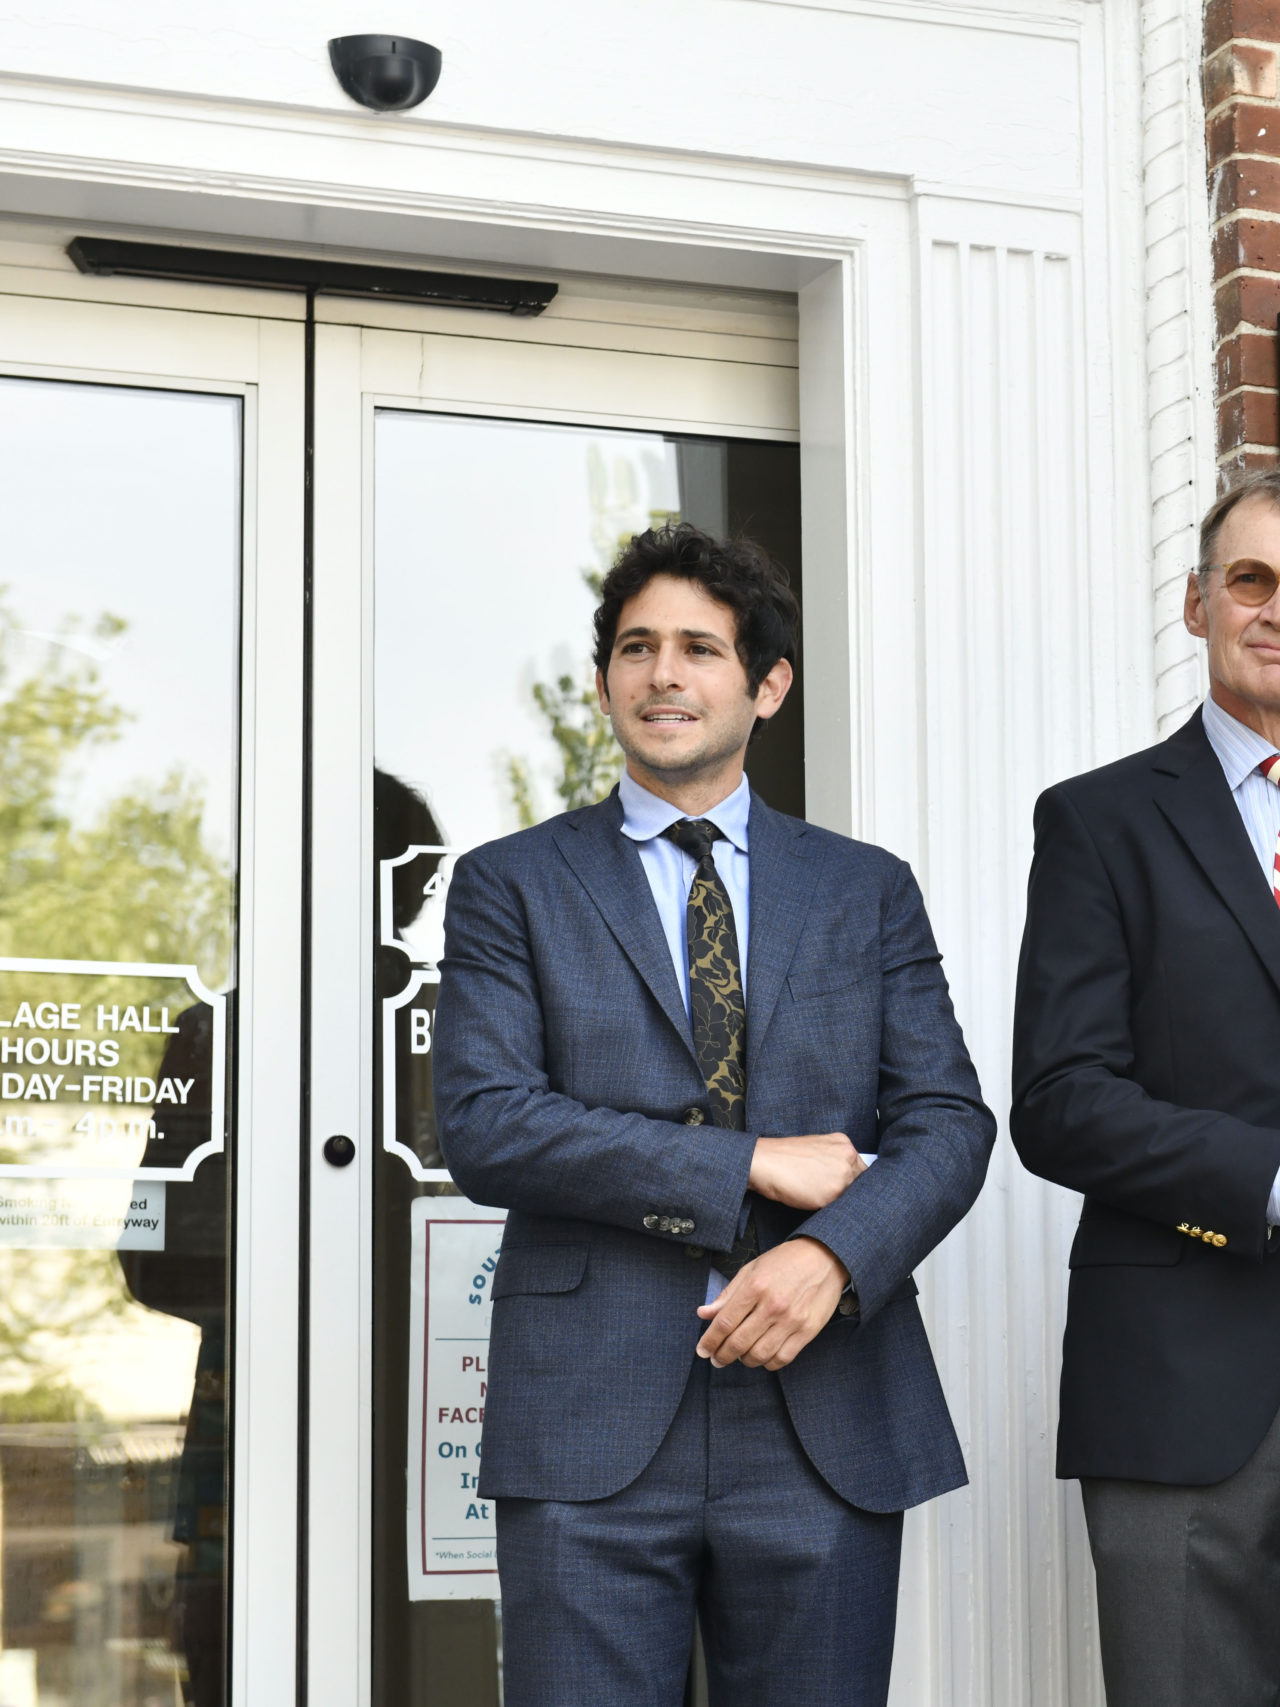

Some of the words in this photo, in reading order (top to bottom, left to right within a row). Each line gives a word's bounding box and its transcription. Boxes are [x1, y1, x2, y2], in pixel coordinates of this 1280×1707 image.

[97, 1004, 180, 1033] HALL
[410, 1008, 437, 1055] B
[1, 1037, 120, 1067] HOURS
[438, 1441, 468, 1459] On
[465, 1503, 490, 1520] At
[466, 1549, 493, 1561] Social
